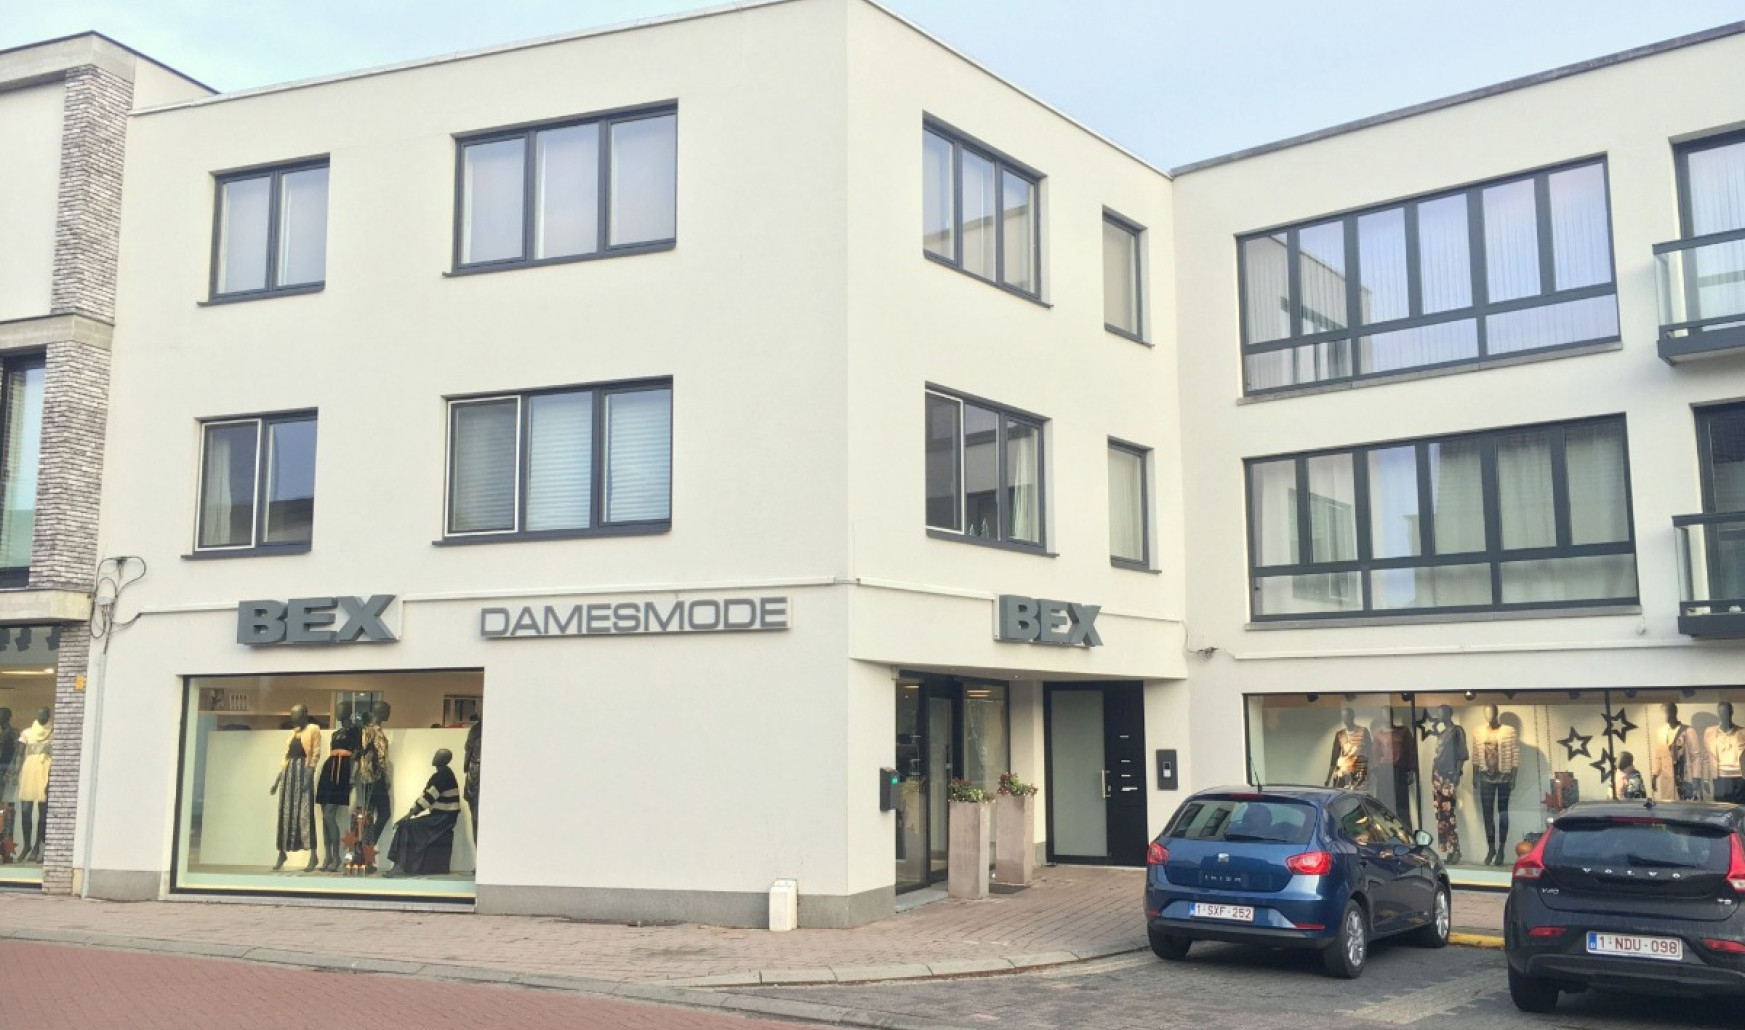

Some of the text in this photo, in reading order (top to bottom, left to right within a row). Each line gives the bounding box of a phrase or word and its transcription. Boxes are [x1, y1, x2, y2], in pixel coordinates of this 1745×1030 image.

[237, 594, 397, 645] BEX
[480, 597, 788, 636] DAMESMODE
[999, 594, 1103, 647] BEX
[1600, 936, 1678, 954] 1-NDU-098
